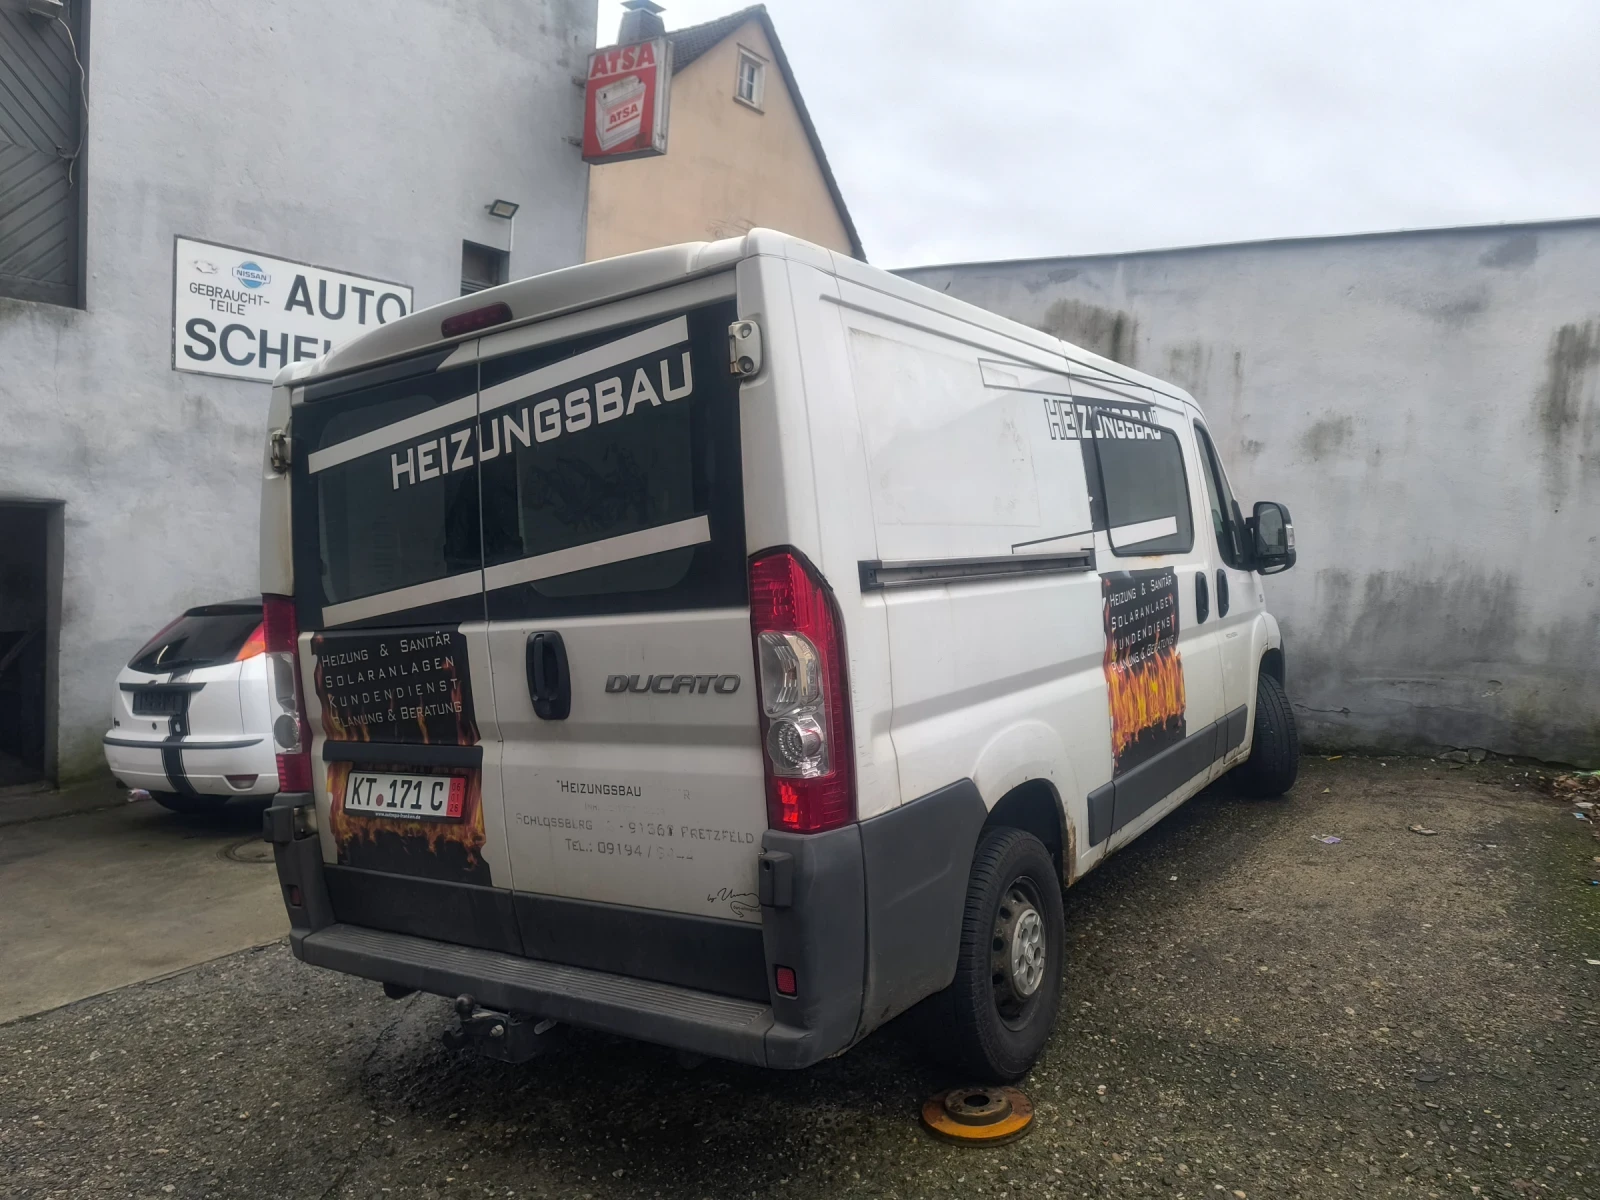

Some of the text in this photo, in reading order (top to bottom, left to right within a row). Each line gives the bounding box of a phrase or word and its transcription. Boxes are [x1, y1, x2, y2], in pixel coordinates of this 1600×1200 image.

[590, 42, 655, 77] ATSA
[609, 104, 638, 124] ATSA
[236, 269, 267, 281] NISSAN
[189, 282, 270, 306] GEBRAUCHT-
[209, 298, 246, 316] TEILE
[284, 274, 406, 325] AUTO
[391, 351, 693, 490] HEIZUNGSBAU
[1110, 573, 1172, 607] HEIZUNG & SANITÄR
[1111, 597, 1174, 631] SOLARANLAGEN
[321, 631, 451, 668] HEIZUNG & SANITÄR
[1112, 614, 1175, 652] KUNDENDIENST
[325, 656, 455, 689] SOLARANLAGEN
[605, 674, 741, 694] DUCATO
[329, 678, 458, 709] KUNDENDIENST
[333, 701, 462, 728] PLANUNG & BERATUNG
[351, 777, 444, 811] KT 171 C
[560, 780, 642, 797] HEIZUNGSBAU
